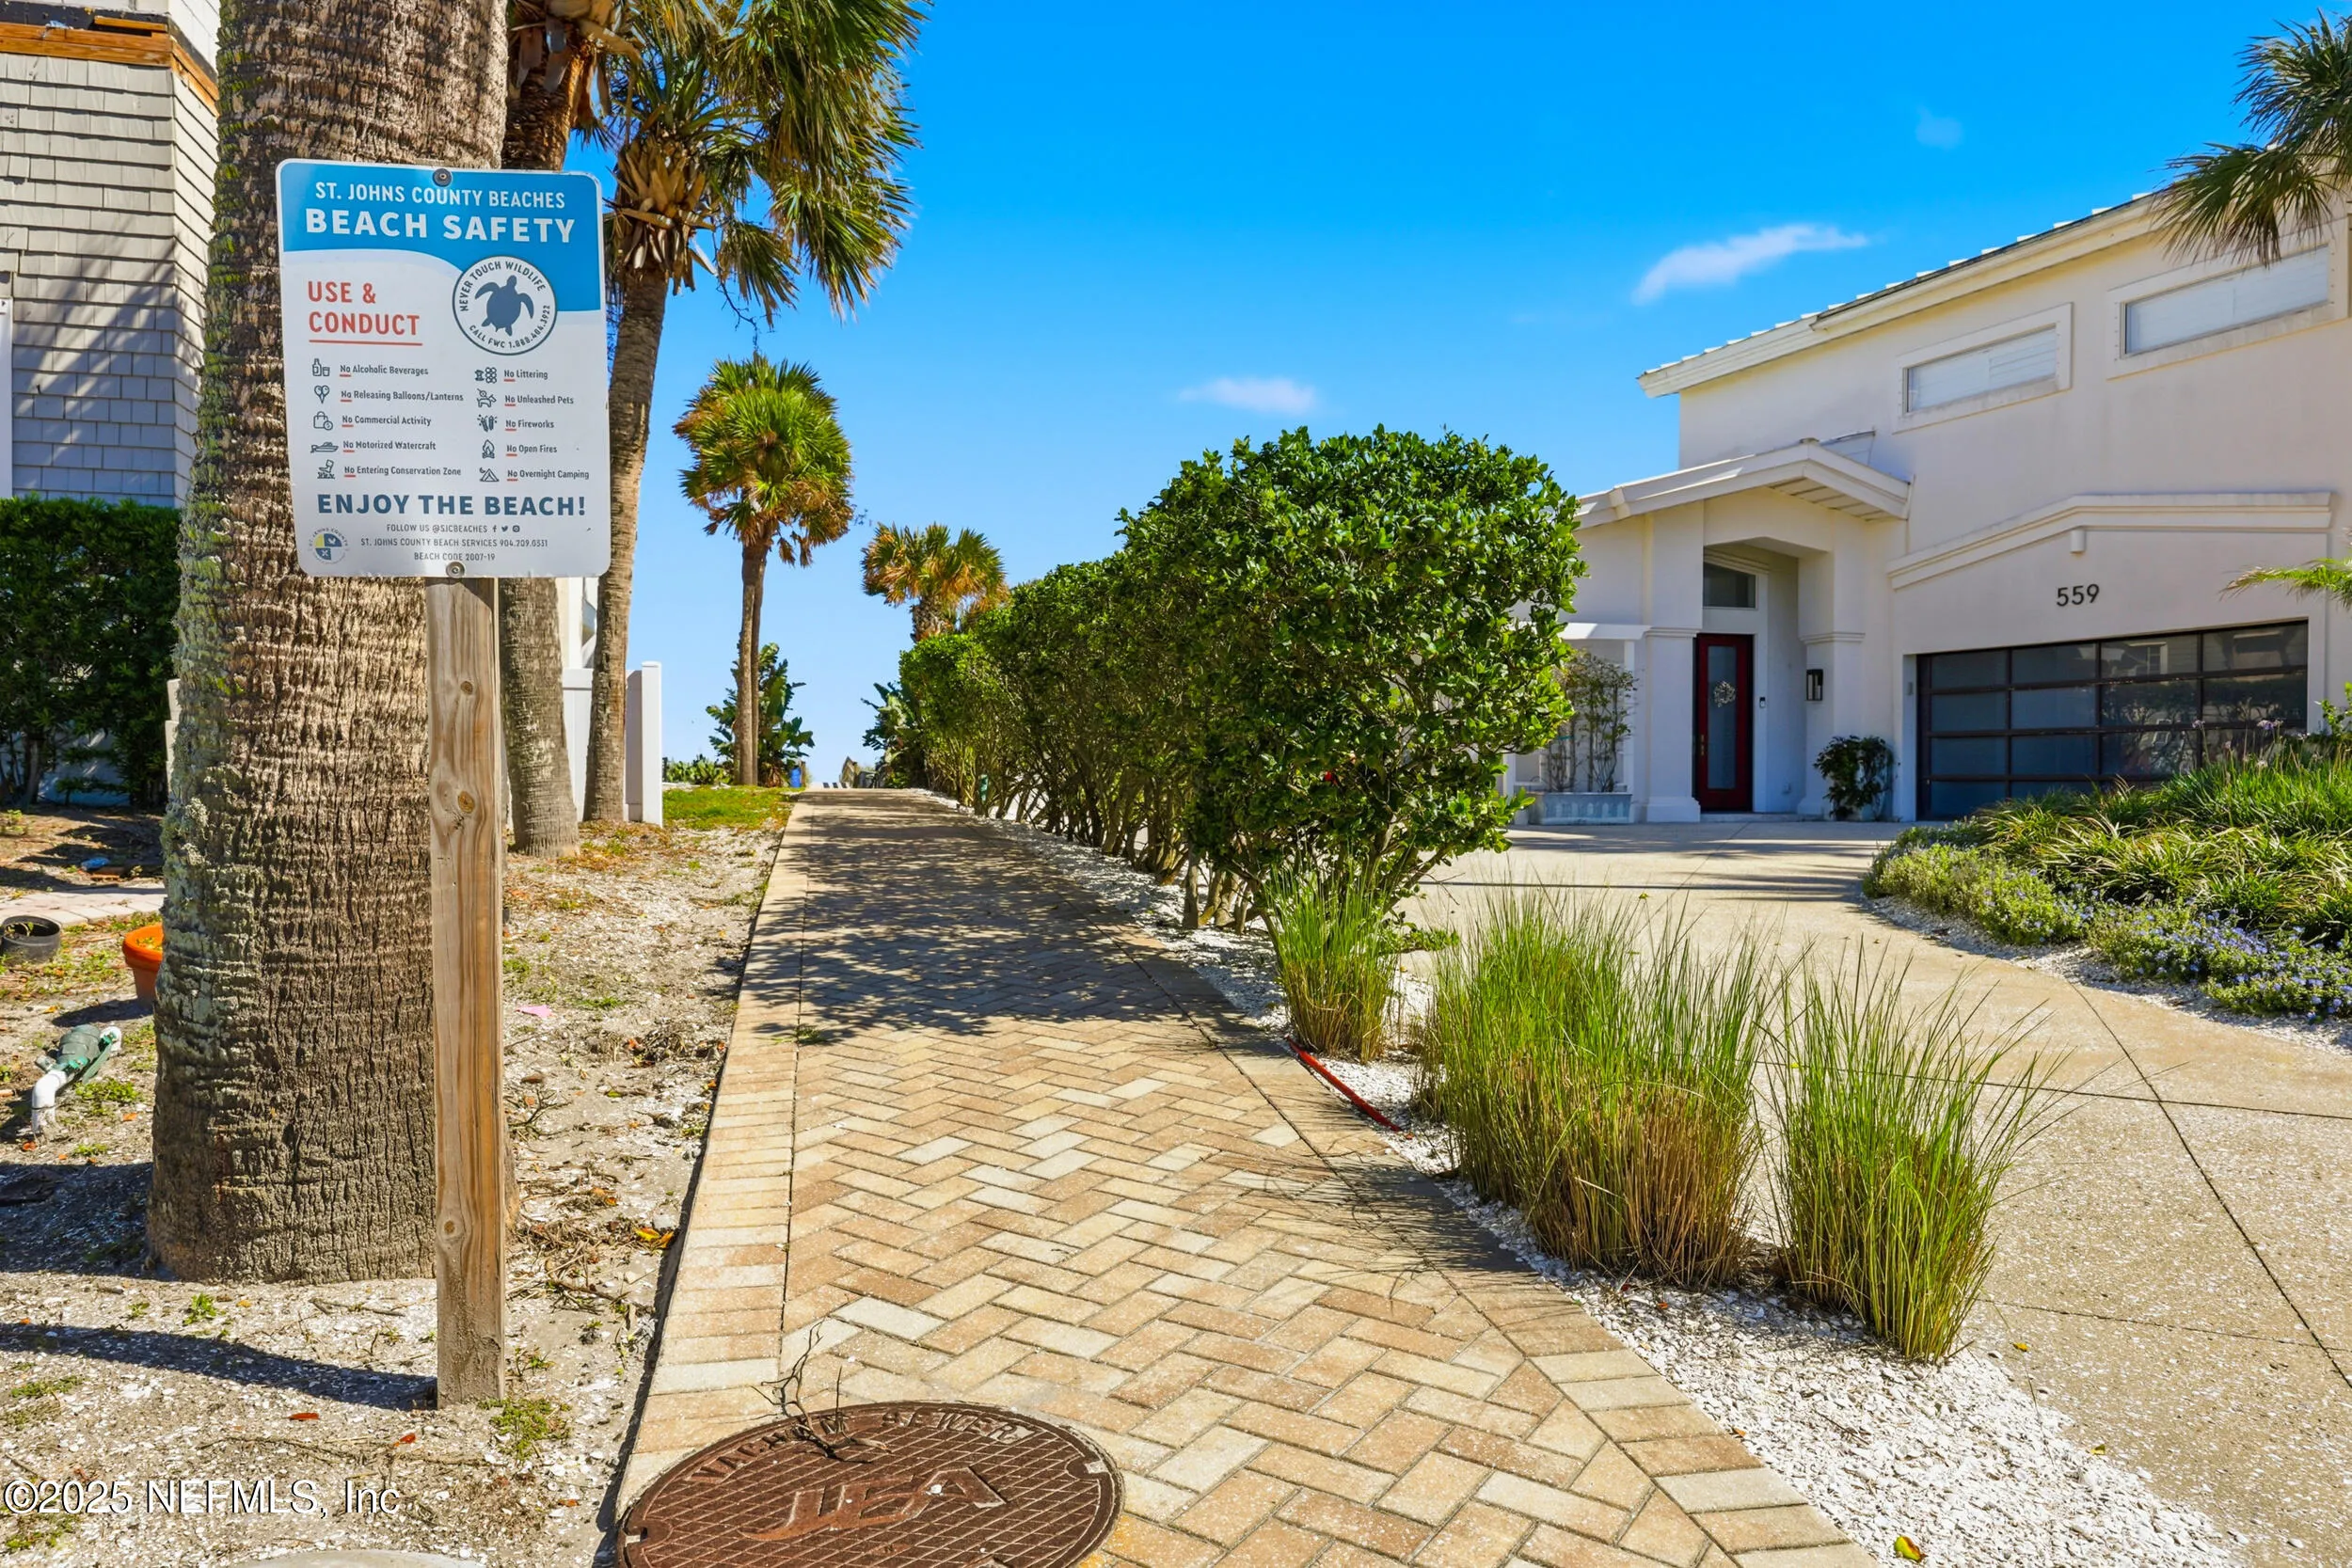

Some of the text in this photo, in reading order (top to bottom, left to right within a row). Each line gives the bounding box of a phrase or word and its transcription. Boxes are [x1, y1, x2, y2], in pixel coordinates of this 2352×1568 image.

[315, 182, 565, 209] ST. JOHNS COUNTY BEACHES
[306, 208, 575, 243] BEACH SAFETY
[308, 280, 376, 304] USE &
[459, 261, 546, 311] NEVER TOUCH WILDLIFE
[309, 311, 420, 336] CONDUCT
[469, 325, 486, 341] CALL
[488, 338, 505, 348] FWC
[353, 364, 388, 373] Alcoholic
[389, 366, 429, 376] Beverages
[503, 370, 548, 380] No Littering
[354, 389, 390, 401] Releasing
[392, 391, 464, 402] Balloons/Lanterns
[517, 395, 556, 404] Unleashed
[557, 396, 574, 404] Pets
[355, 415, 400, 424] Commercial
[402, 417, 432, 426] Activity
[505, 420, 555, 428] No Fireworks
[342, 440, 437, 451] No Motorized Watercraft
[518, 445, 538, 454] Open
[539, 444, 558, 452] Fires
[357, 466, 389, 476] Entering
[390, 467, 441, 475] Conservation
[443, 467, 462, 476] Zone
[507, 469, 590, 481] No Overnight Camping
[317, 494, 586, 515] ENJOY THE BEACH!
[387, 524, 487, 533] FOLLOW US @SJCBEACHES
[360, 537, 373, 546] ST.
[374, 537, 398, 546] JOHNS
[400, 538, 431, 546] COUNTY
[434, 538, 459, 546] BEACH
[462, 539, 498, 547] SERVICES
[414, 552, 496, 562] BEACH CODE 2007-19
[2057, 583, 2100, 607] 559
[881, 1408, 1020, 1445] SEWER
